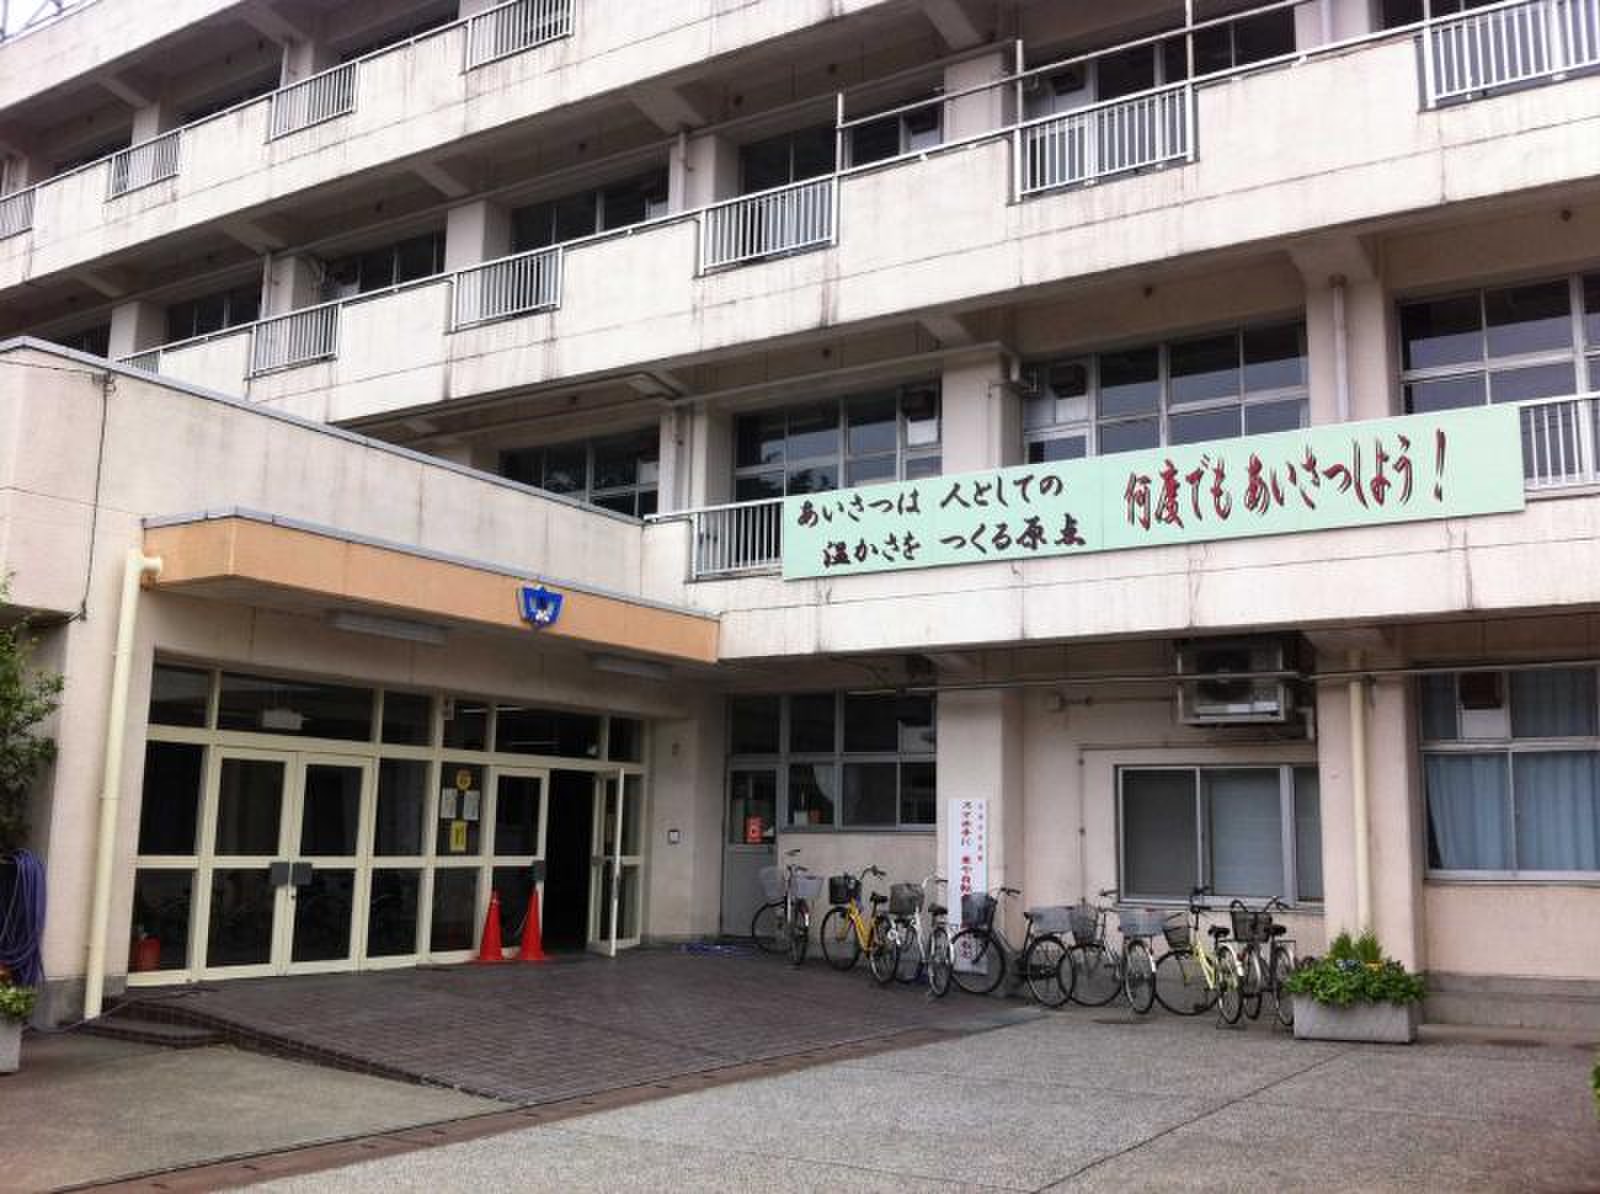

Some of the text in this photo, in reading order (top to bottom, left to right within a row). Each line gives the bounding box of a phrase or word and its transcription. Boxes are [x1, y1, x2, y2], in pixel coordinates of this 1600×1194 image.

[798, 474, 1064, 528] あいさつは 人としての
[1123, 454, 1232, 529] 何度でも
[823, 513, 1087, 567] 温かさを つくる原点
